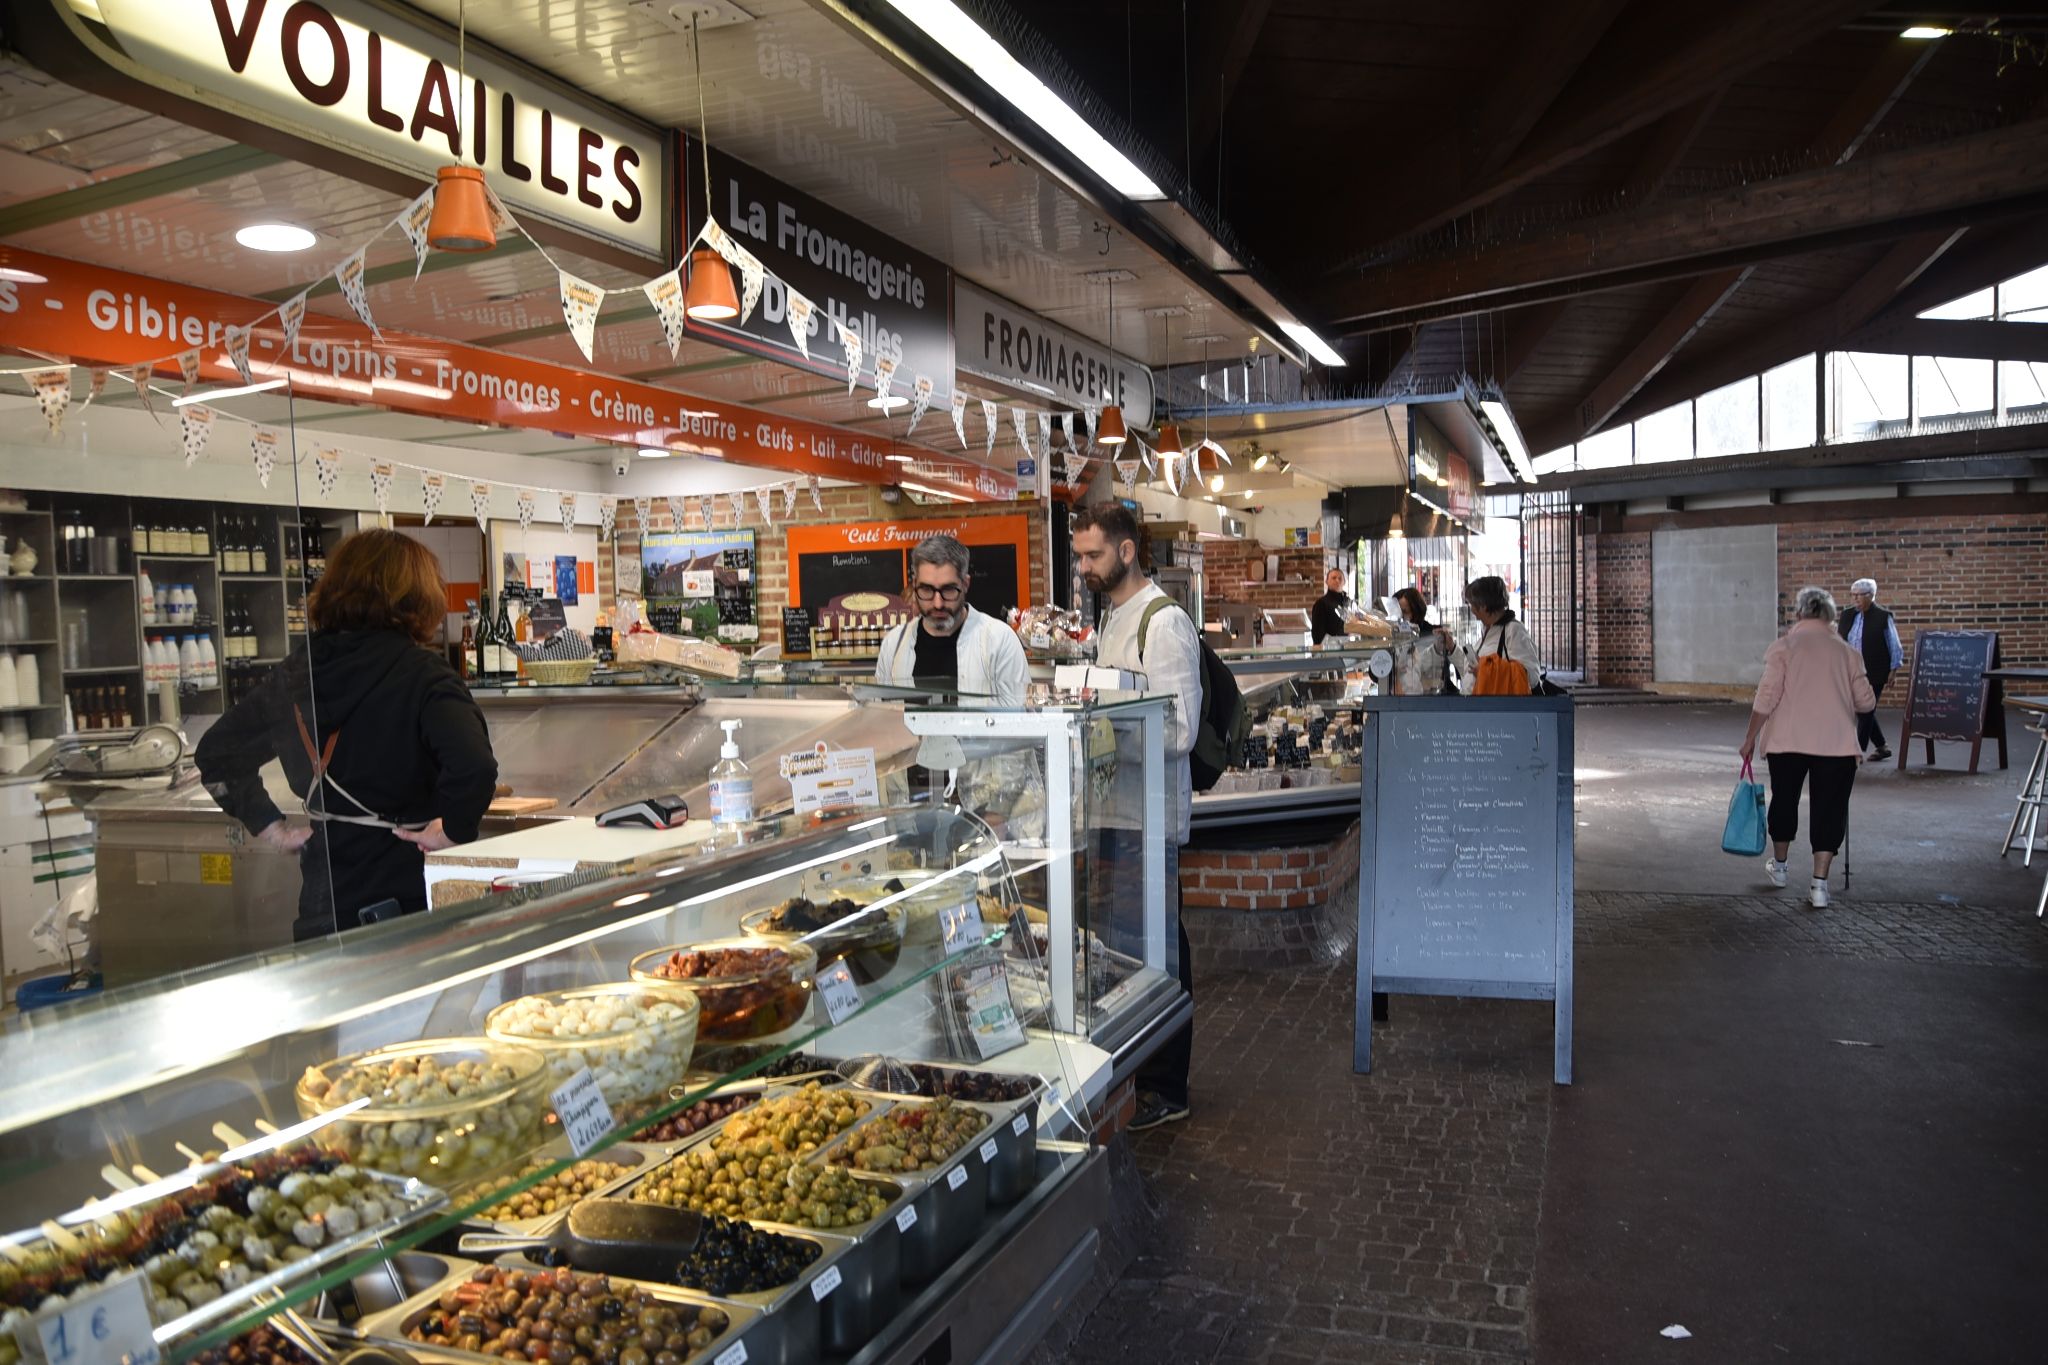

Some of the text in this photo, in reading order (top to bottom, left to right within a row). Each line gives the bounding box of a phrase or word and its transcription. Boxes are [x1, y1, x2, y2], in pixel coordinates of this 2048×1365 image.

[211, 0, 642, 223] VOLAILLES
[730, 179, 924, 309] La Fromagerie
[763, 275, 902, 361] Ds Halles
[984, 312, 1125, 409] FROMAGERIE
[292, 333, 397, 379] Lapins
[437, 359, 560, 412] Fromages
[589, 389, 655, 426] Crème
[679, 407, 736, 441] Beurre
[756, 423, 794, 452] Œufs
[811, 433, 836, 459] Lait
[851, 445, 883, 468] Cidre
